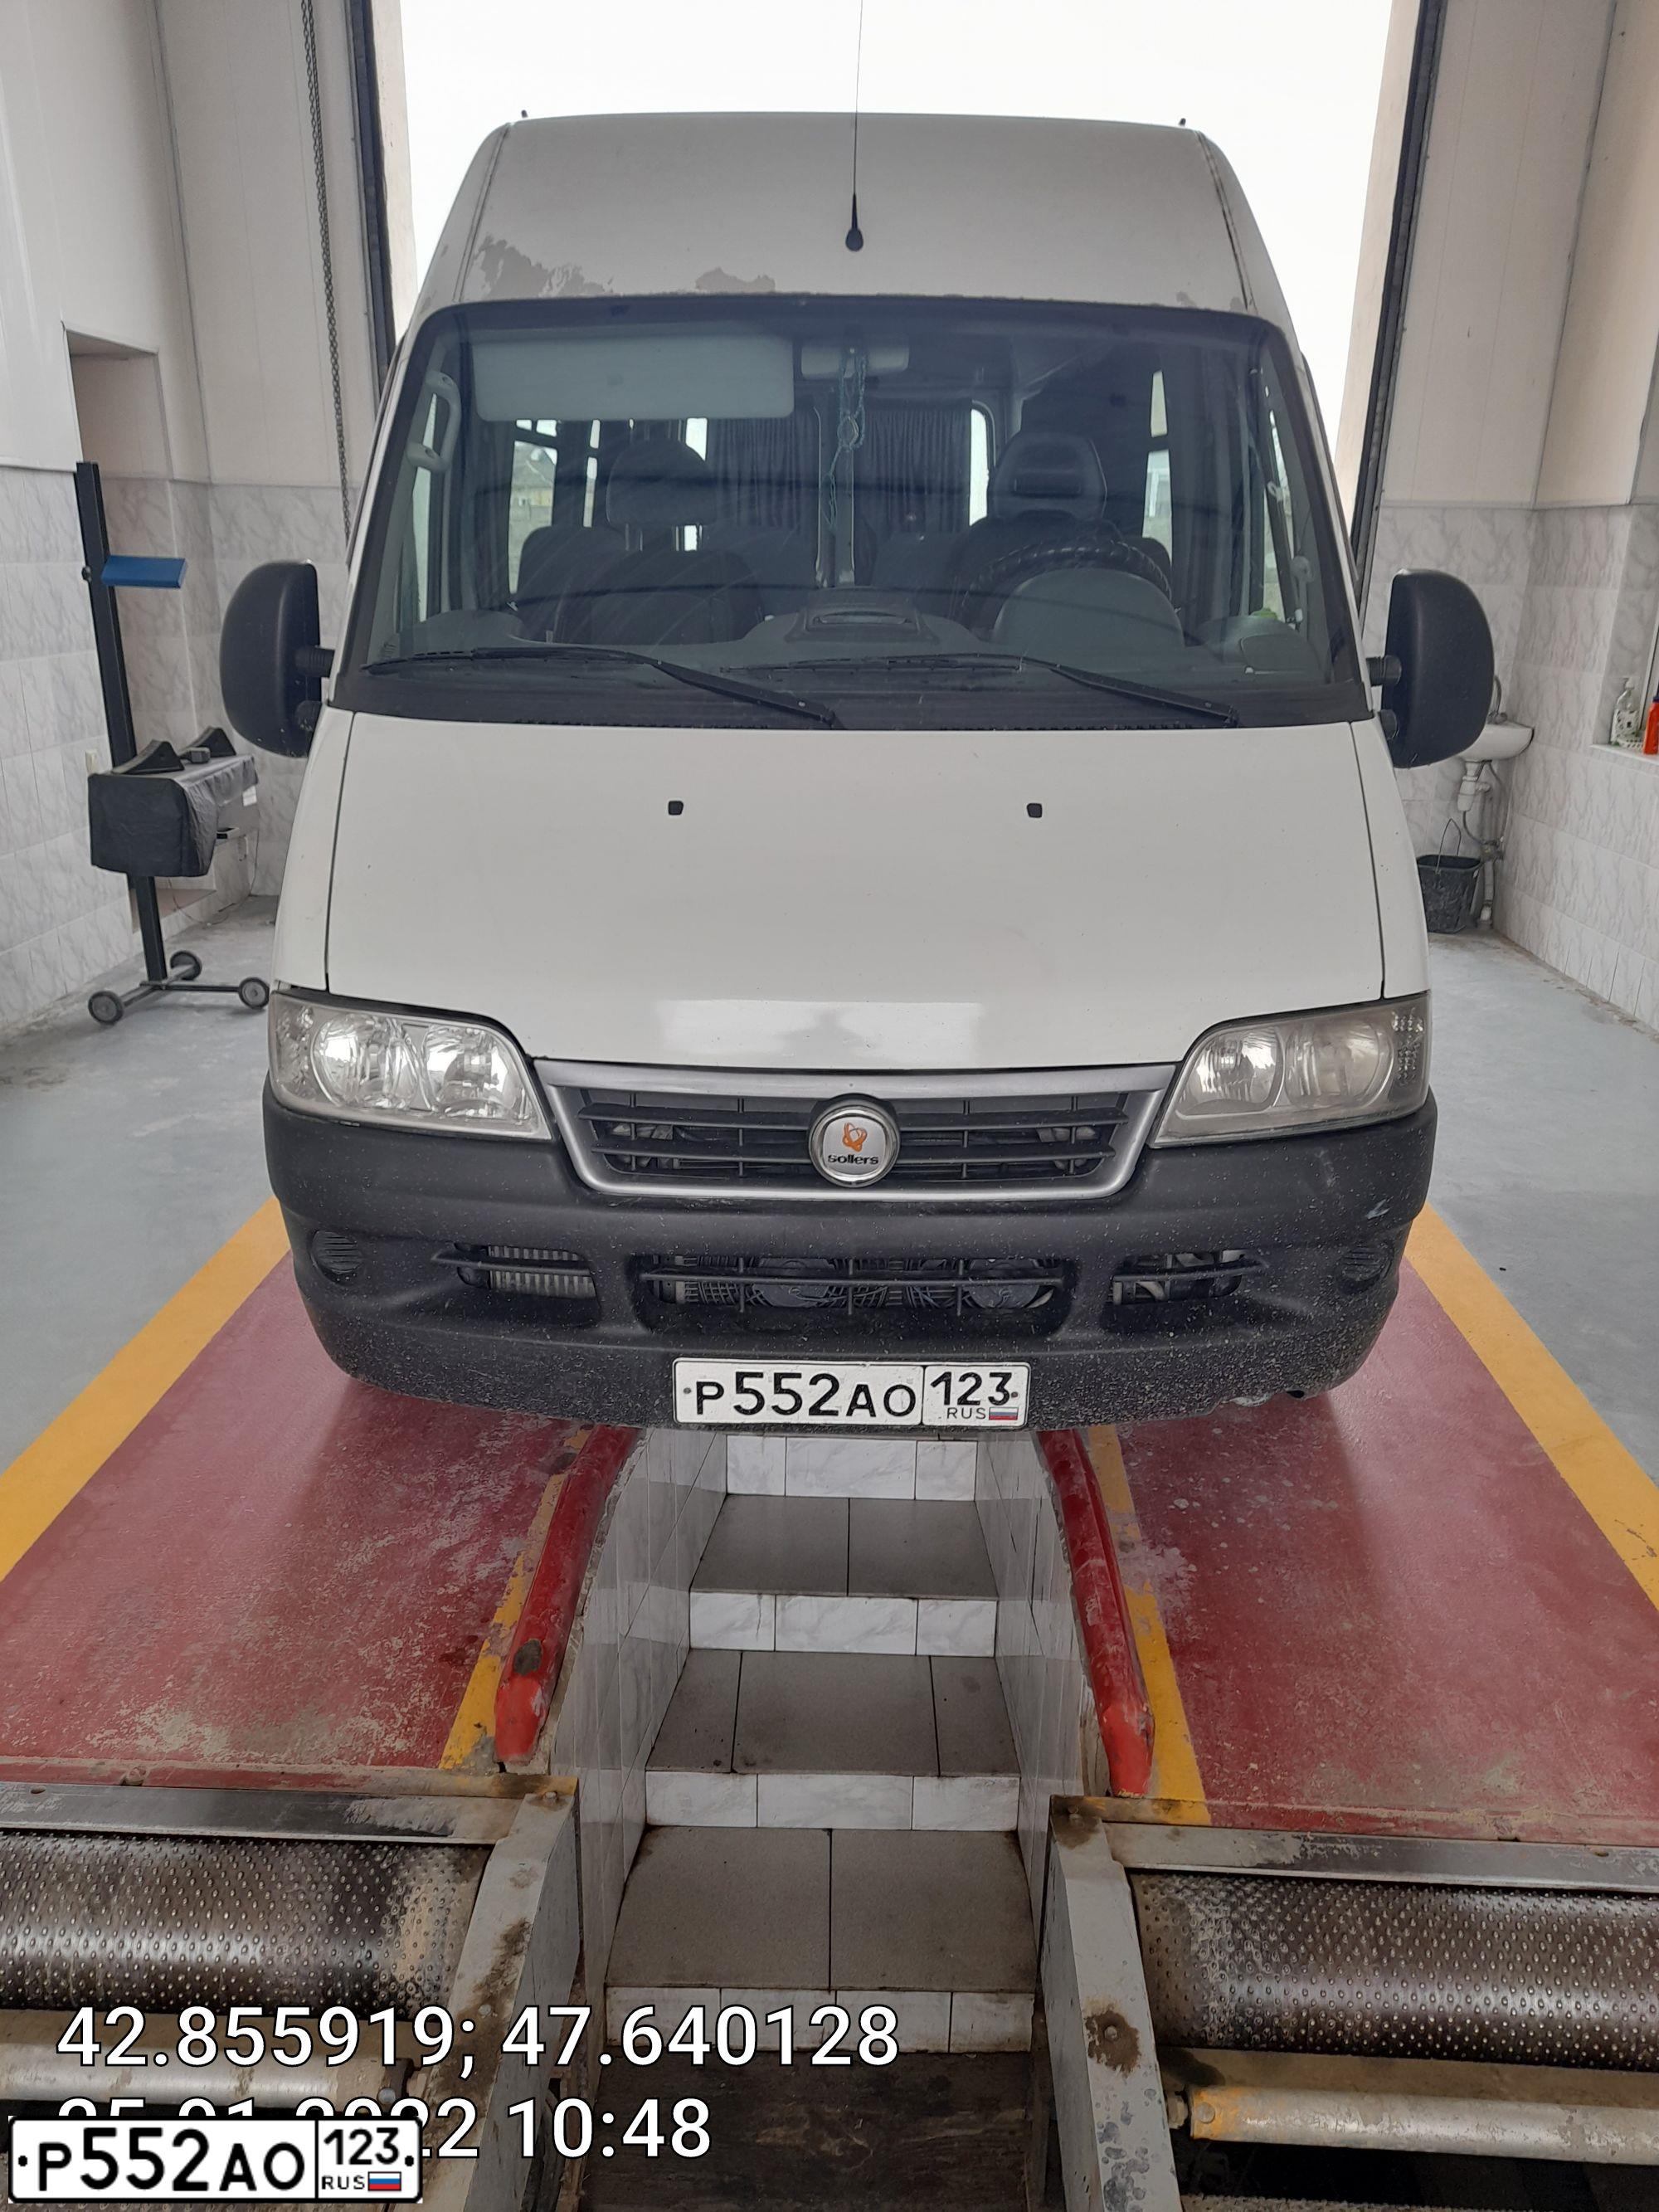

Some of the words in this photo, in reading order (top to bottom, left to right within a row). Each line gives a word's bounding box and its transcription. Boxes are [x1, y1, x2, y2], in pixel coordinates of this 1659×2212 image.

[828, 1154, 879, 1165] sollers
[930, 1371, 1013, 1406] 123
[946, 1406, 986, 1420] RUS
